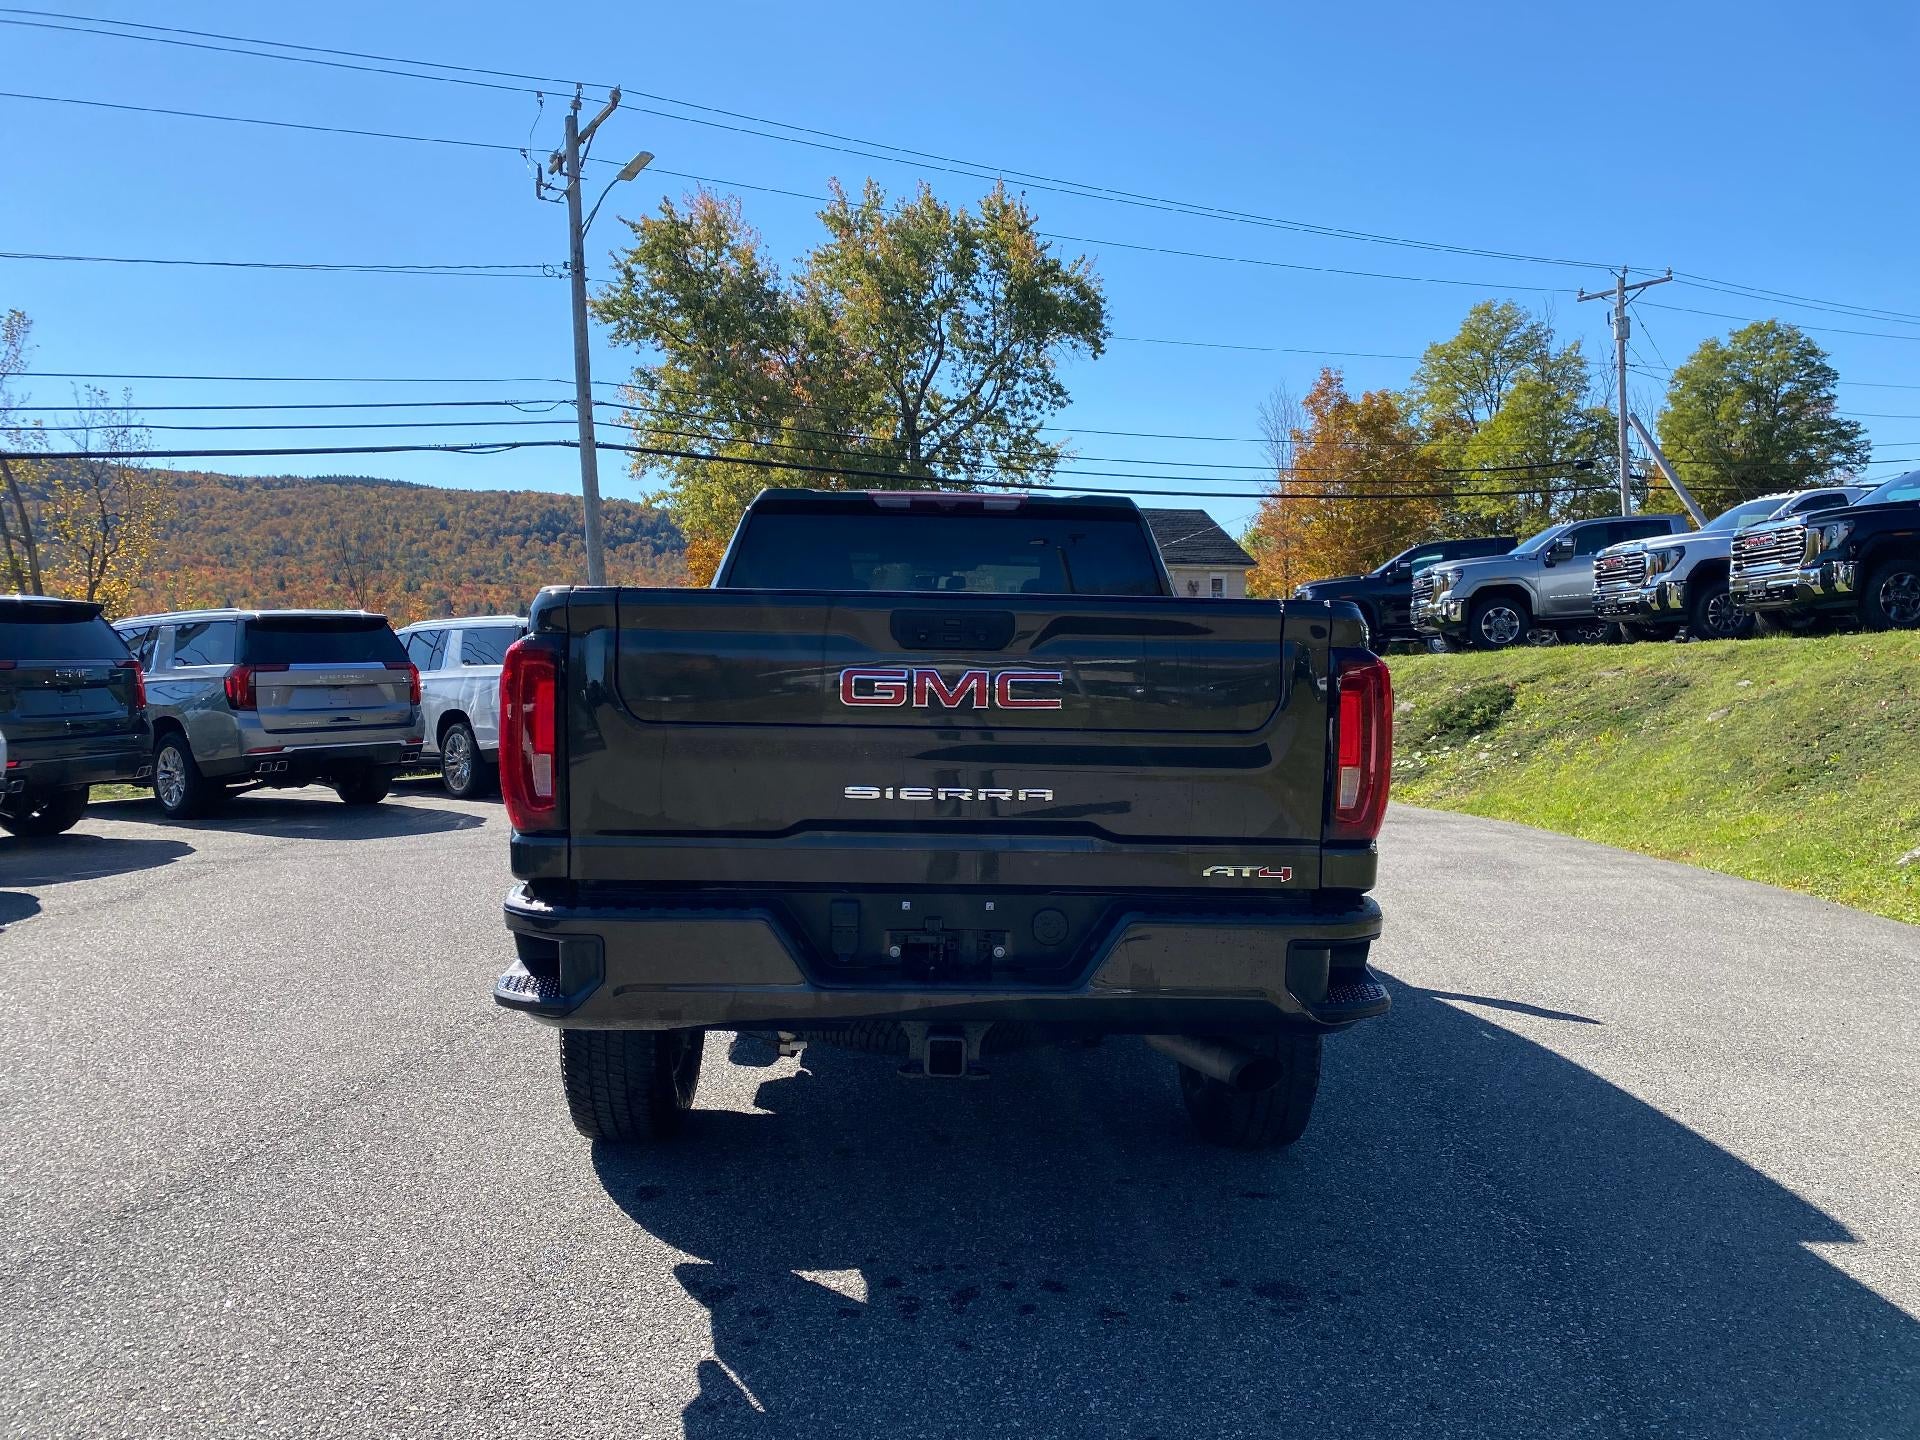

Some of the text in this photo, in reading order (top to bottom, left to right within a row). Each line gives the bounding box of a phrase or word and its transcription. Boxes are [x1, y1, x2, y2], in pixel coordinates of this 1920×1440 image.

[840, 668, 1062, 709] GMC
[844, 786, 1053, 801] SIERRA
[1202, 866, 1292, 882] AT4
